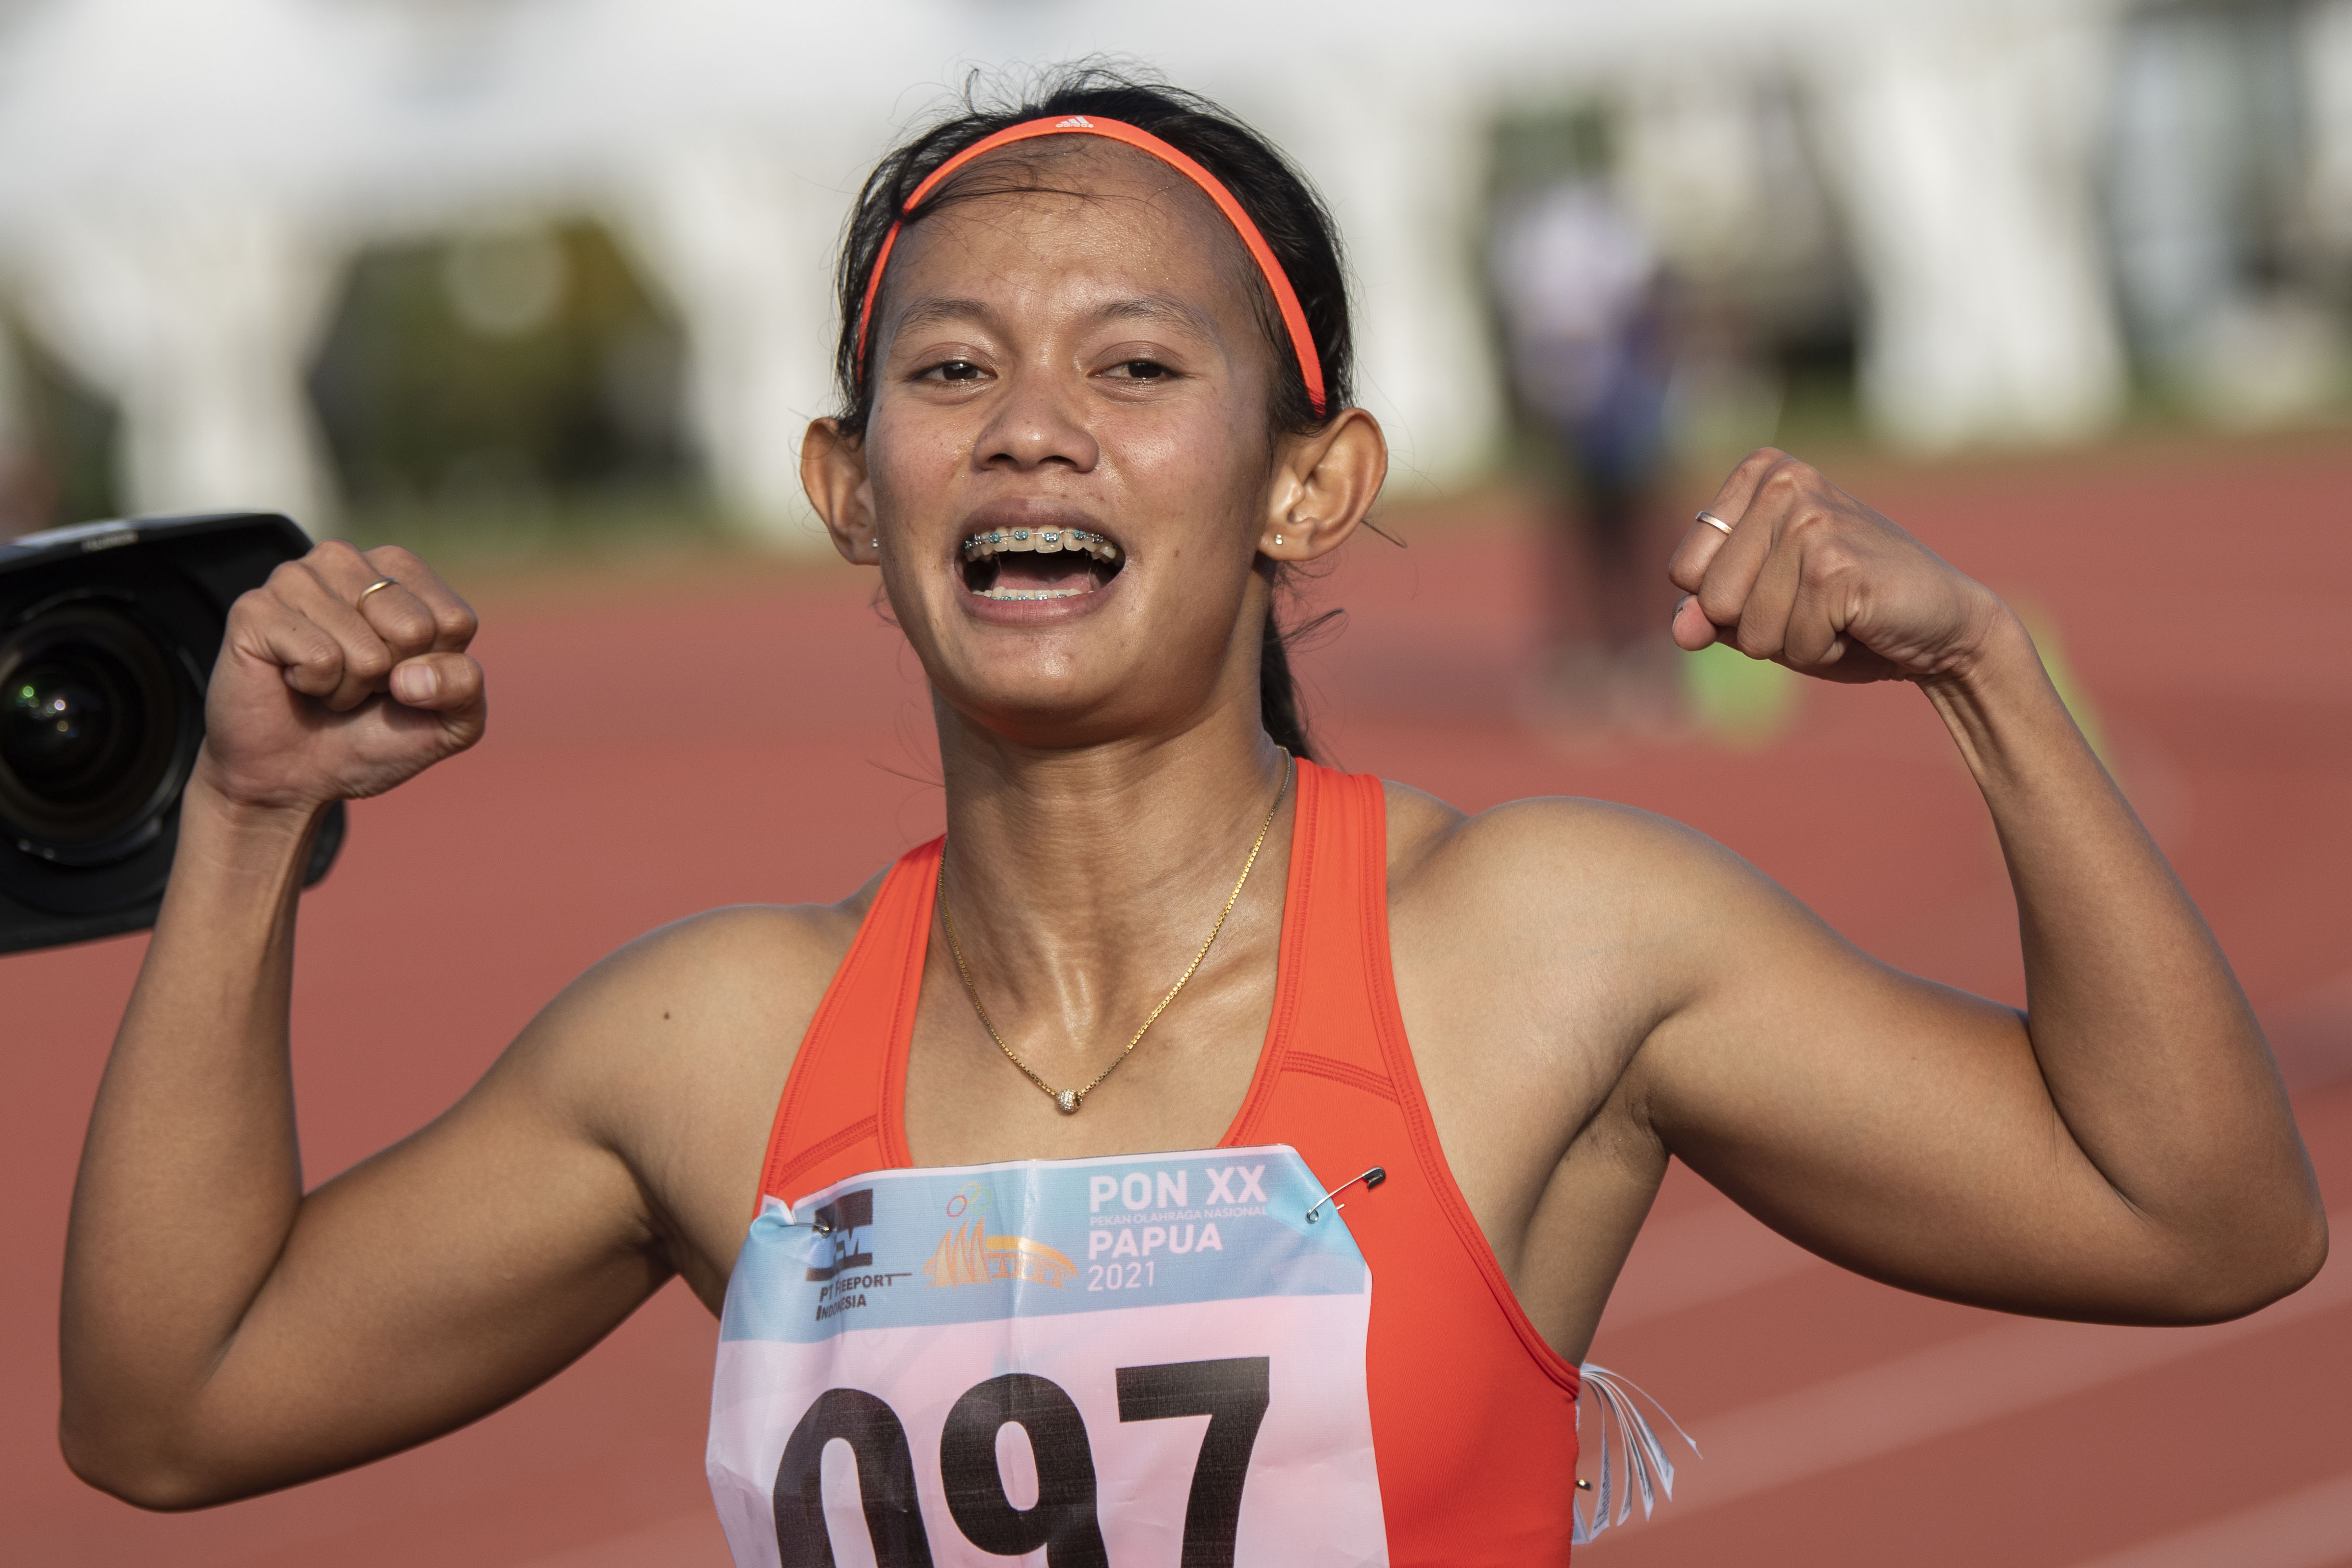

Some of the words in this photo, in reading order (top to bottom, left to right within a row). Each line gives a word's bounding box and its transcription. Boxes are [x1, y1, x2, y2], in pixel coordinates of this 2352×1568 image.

[1089, 1170, 1188, 1213] PON
[1205, 1164, 1267, 1205] XX
[1089, 1215, 1131, 1226] PEKAN
[1133, 1209, 1202, 1224] OLAHRAGA
[1205, 1206, 1267, 1219] NASIONAL
[1088, 1222, 1223, 1260] PAPUA
[1087, 1261, 1155, 1292] 2021
[816, 1294, 867, 1321] INDONESIA
[820, 1285, 833, 1302] PT
[773, 1356, 1271, 1568] 097
